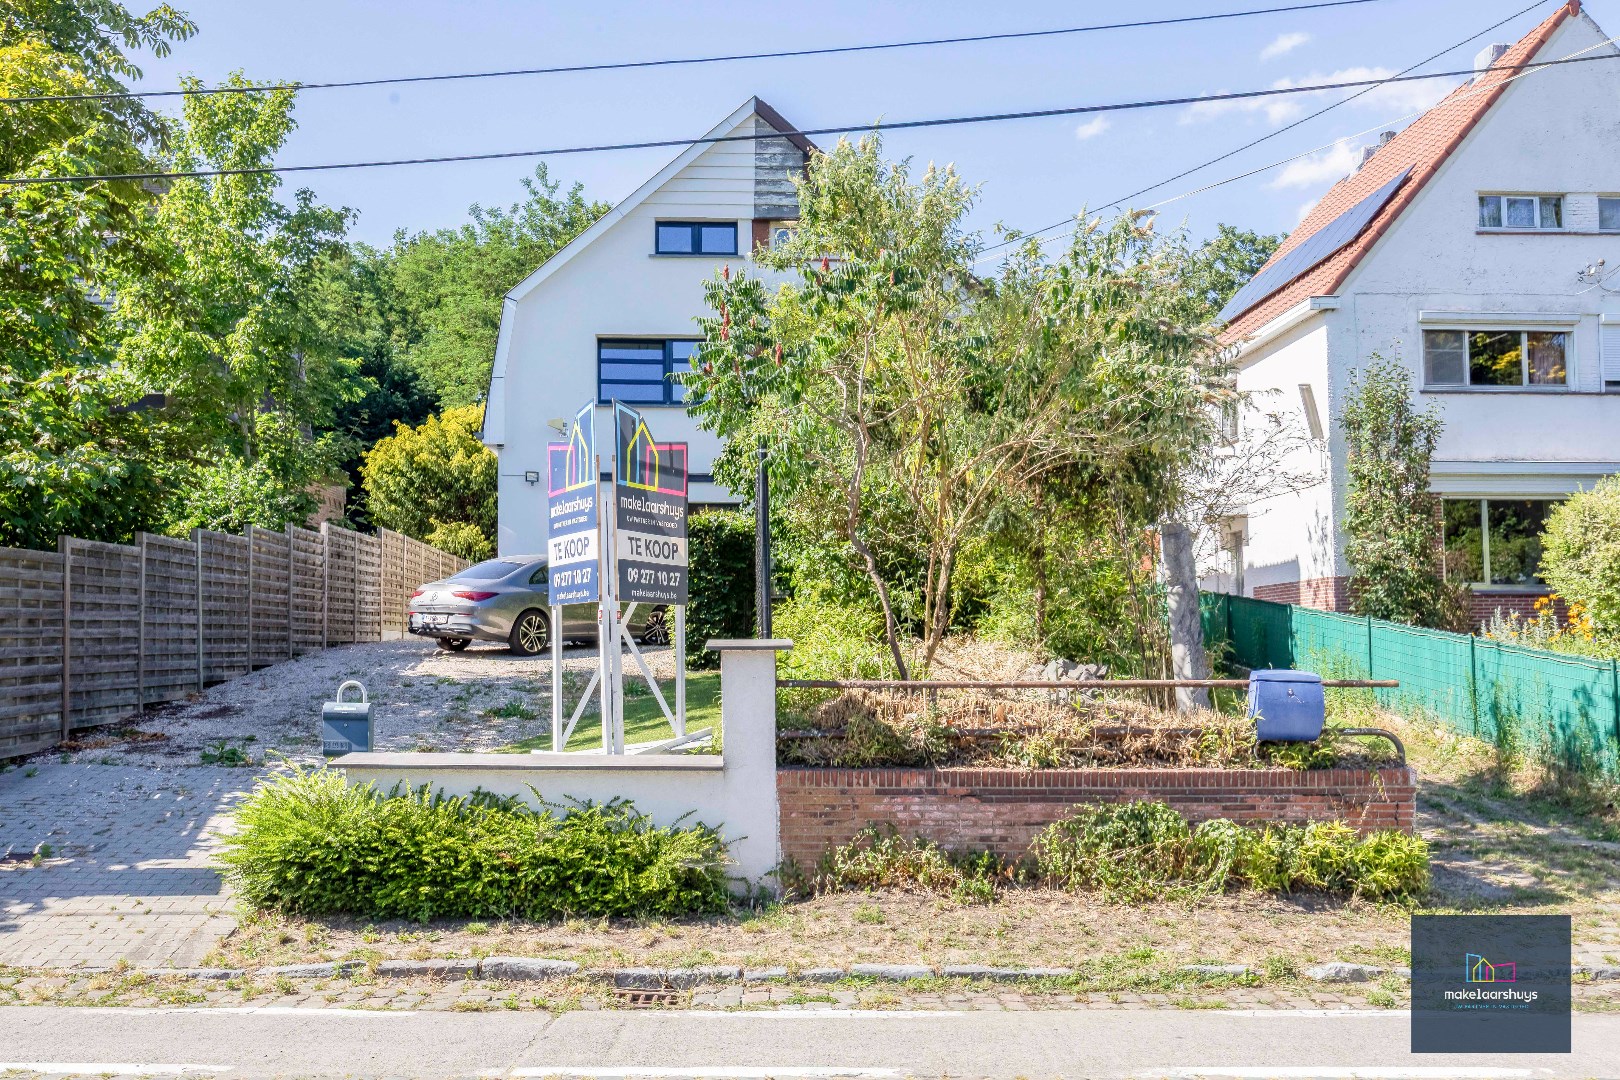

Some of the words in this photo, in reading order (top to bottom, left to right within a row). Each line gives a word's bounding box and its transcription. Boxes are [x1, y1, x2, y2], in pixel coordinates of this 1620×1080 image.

[620, 495, 684, 520] makelaarshuys
[554, 543, 562, 560] TE
[564, 537, 590, 559] KOOP
[627, 536, 642, 556] TE
[644, 538, 678, 560] KOOP
[553, 572, 560, 587] 09
[561, 570, 571, 586] 277
[573, 569, 581, 585] 10
[582, 567, 591, 583] 27
[627, 567, 639, 583] 09
[640, 569, 655, 585] 277
[657, 571, 668, 586] 10
[669, 572, 680, 587] 27
